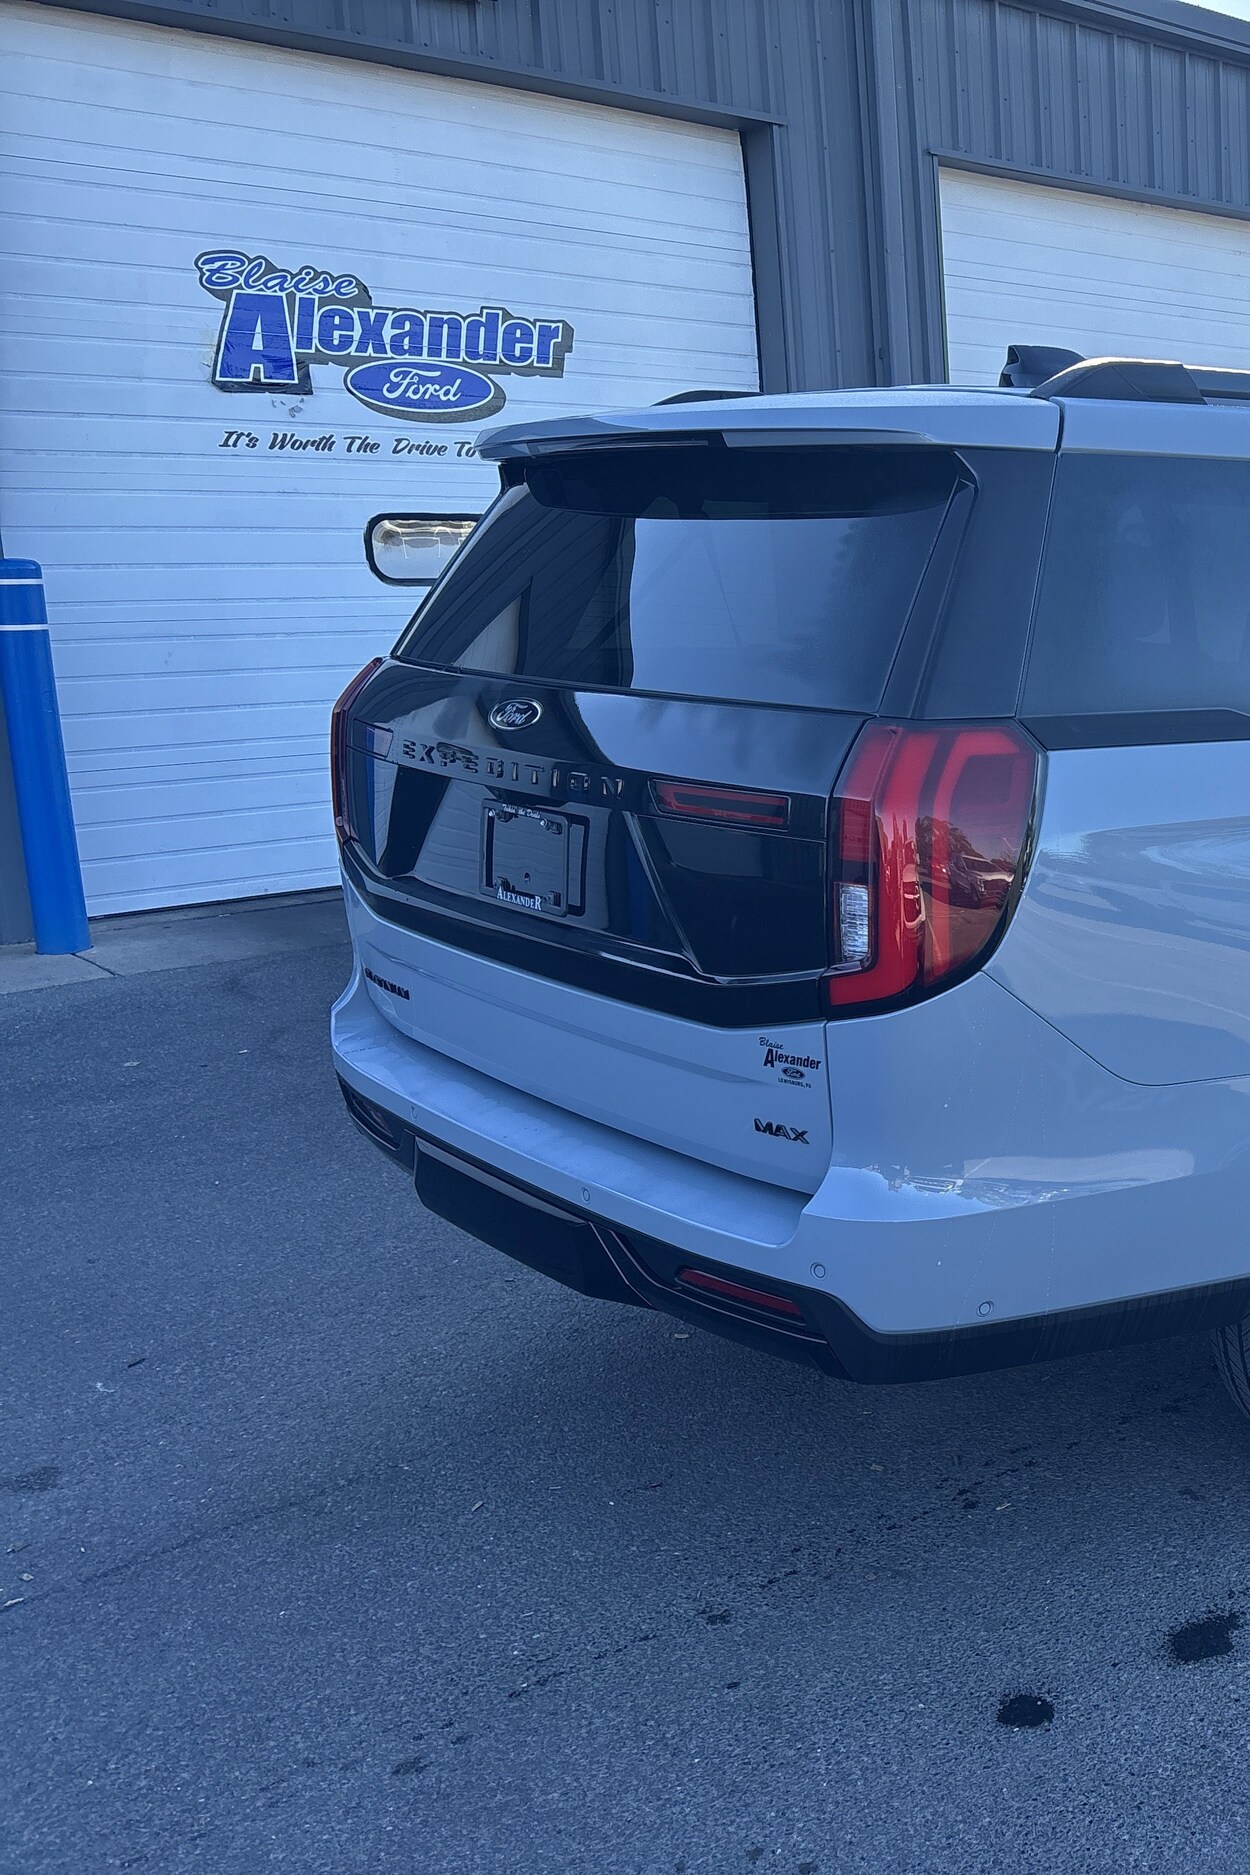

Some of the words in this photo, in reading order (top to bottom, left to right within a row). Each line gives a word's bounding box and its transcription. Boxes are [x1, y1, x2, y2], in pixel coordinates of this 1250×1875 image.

[198, 253, 359, 298] Blaise
[214, 289, 565, 384] Alexander
[382, 366, 464, 404] Ford
[218, 430, 259, 450] It's
[268, 432, 337, 453] Worth
[343, 435, 381, 455] The
[391, 437, 448, 457] Drive
[454, 440, 477, 458] To
[402, 739, 624, 800] EXPEDITION
[758, 1036, 784, 1050] Blaise
[763, 1048, 822, 1070] Alexander
[753, 1117, 810, 1145] MAX
